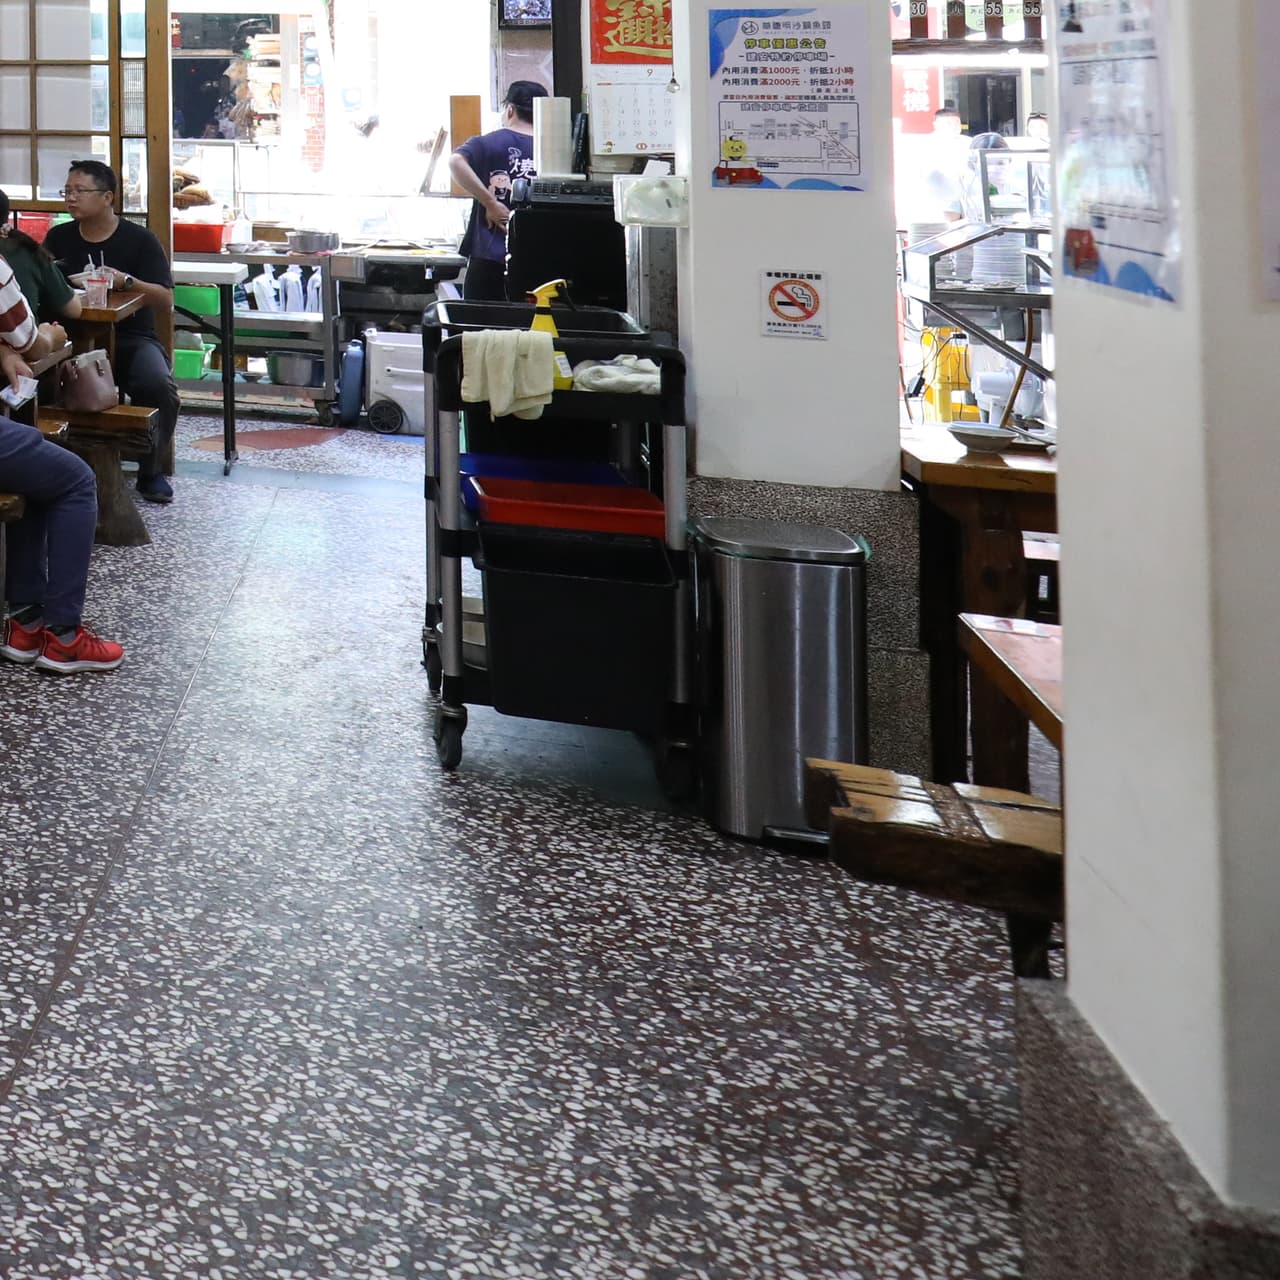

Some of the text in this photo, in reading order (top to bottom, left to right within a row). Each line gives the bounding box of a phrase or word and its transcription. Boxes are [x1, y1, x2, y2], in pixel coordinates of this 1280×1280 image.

[911, 2, 926, 15] 30
[986, 1, 1001, 15] 55
[1024, 1, 1040, 15] 55
[744, 38, 826, 49] 停車優惠公告
[647, 68, 654, 77] 9
